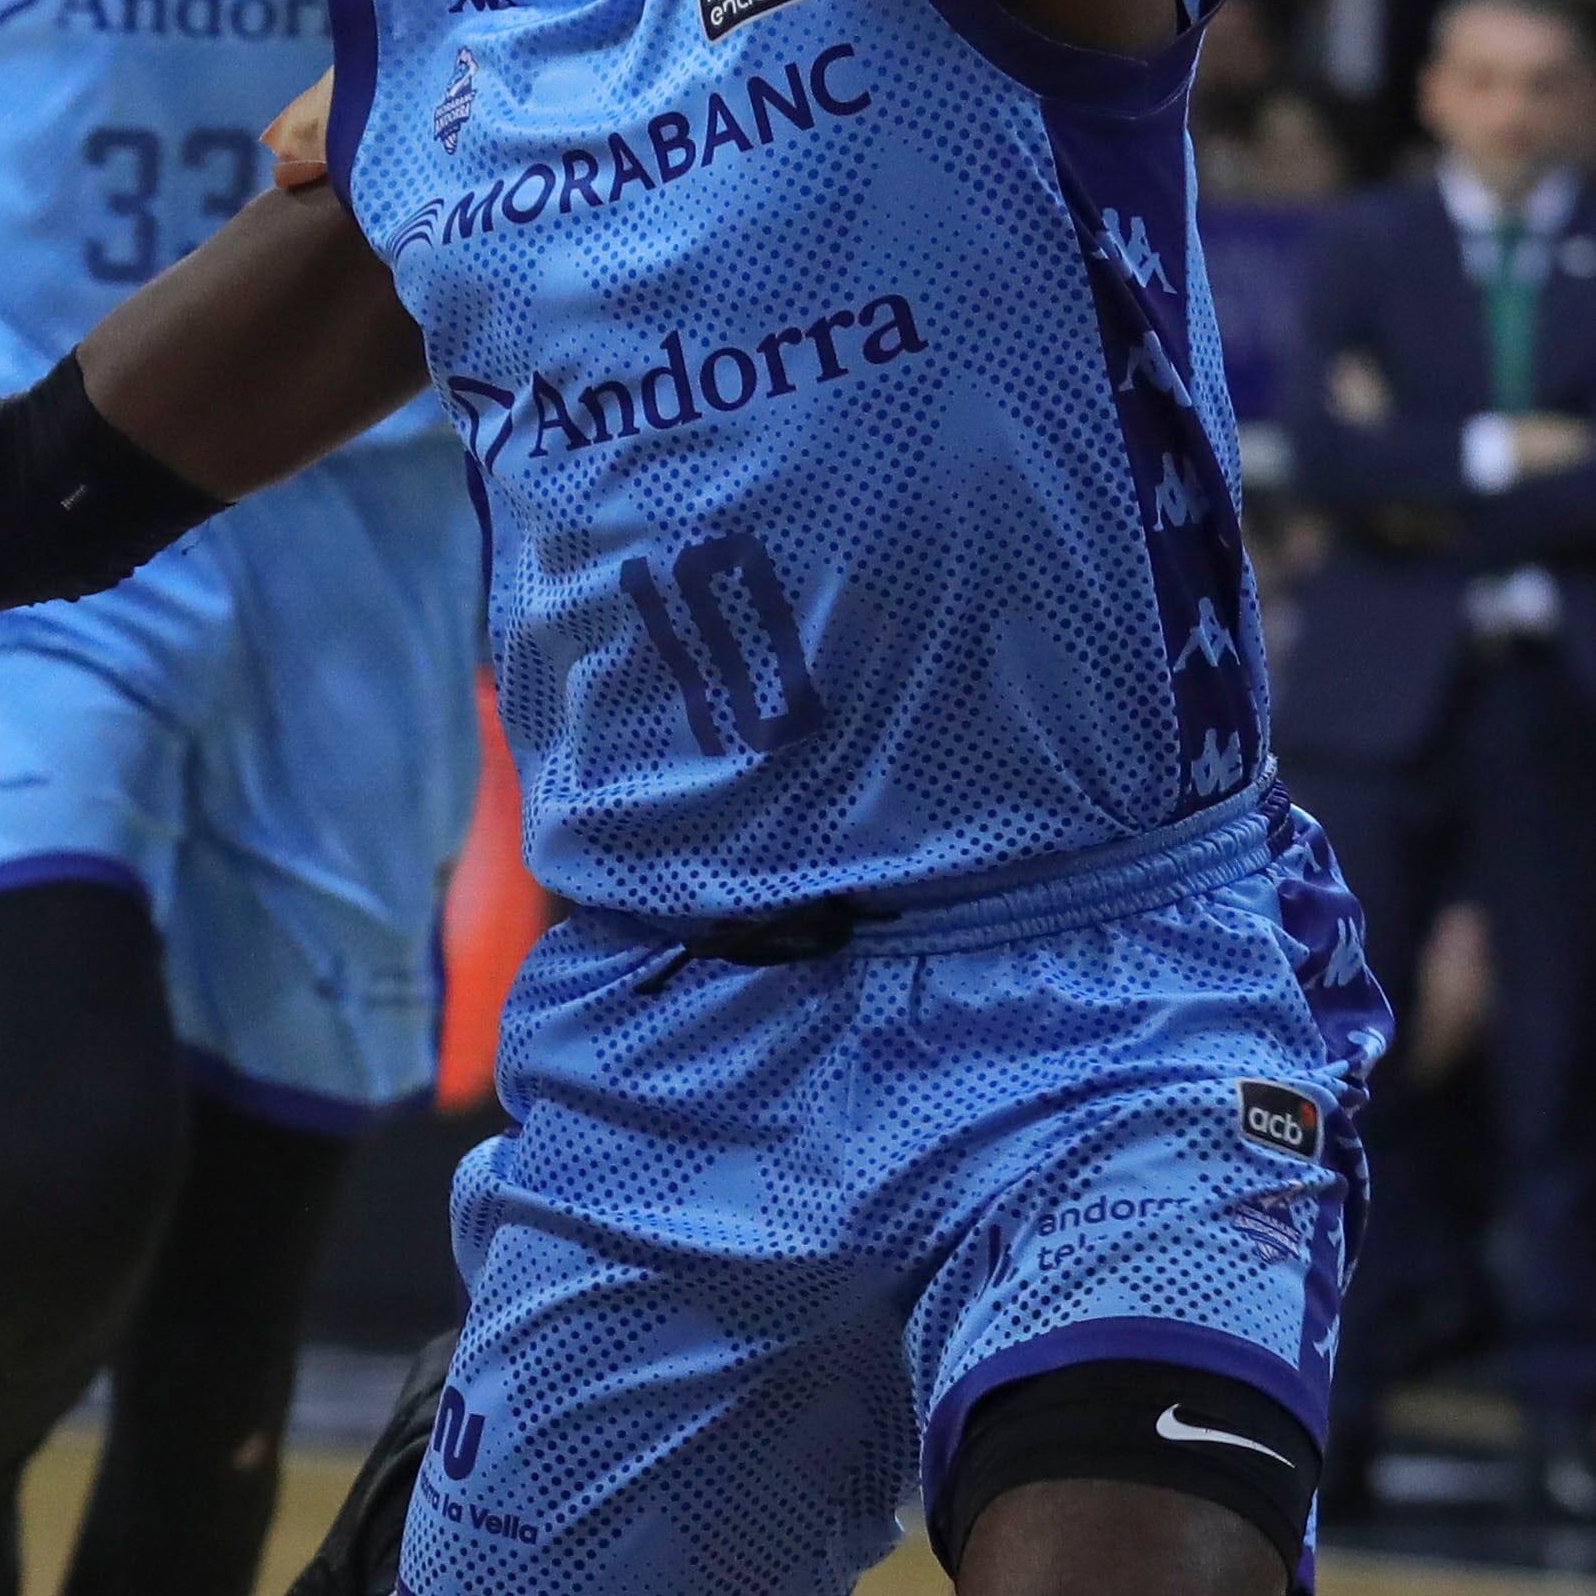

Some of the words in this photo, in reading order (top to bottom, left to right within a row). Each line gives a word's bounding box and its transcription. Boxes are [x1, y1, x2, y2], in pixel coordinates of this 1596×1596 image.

[442, 43, 872, 245] MORABANC
[527, 293, 929, 458] Andorra
[619, 531, 826, 757] 10
[1248, 1107, 1303, 1146] acb
[470, 1503, 538, 1545] Vella
